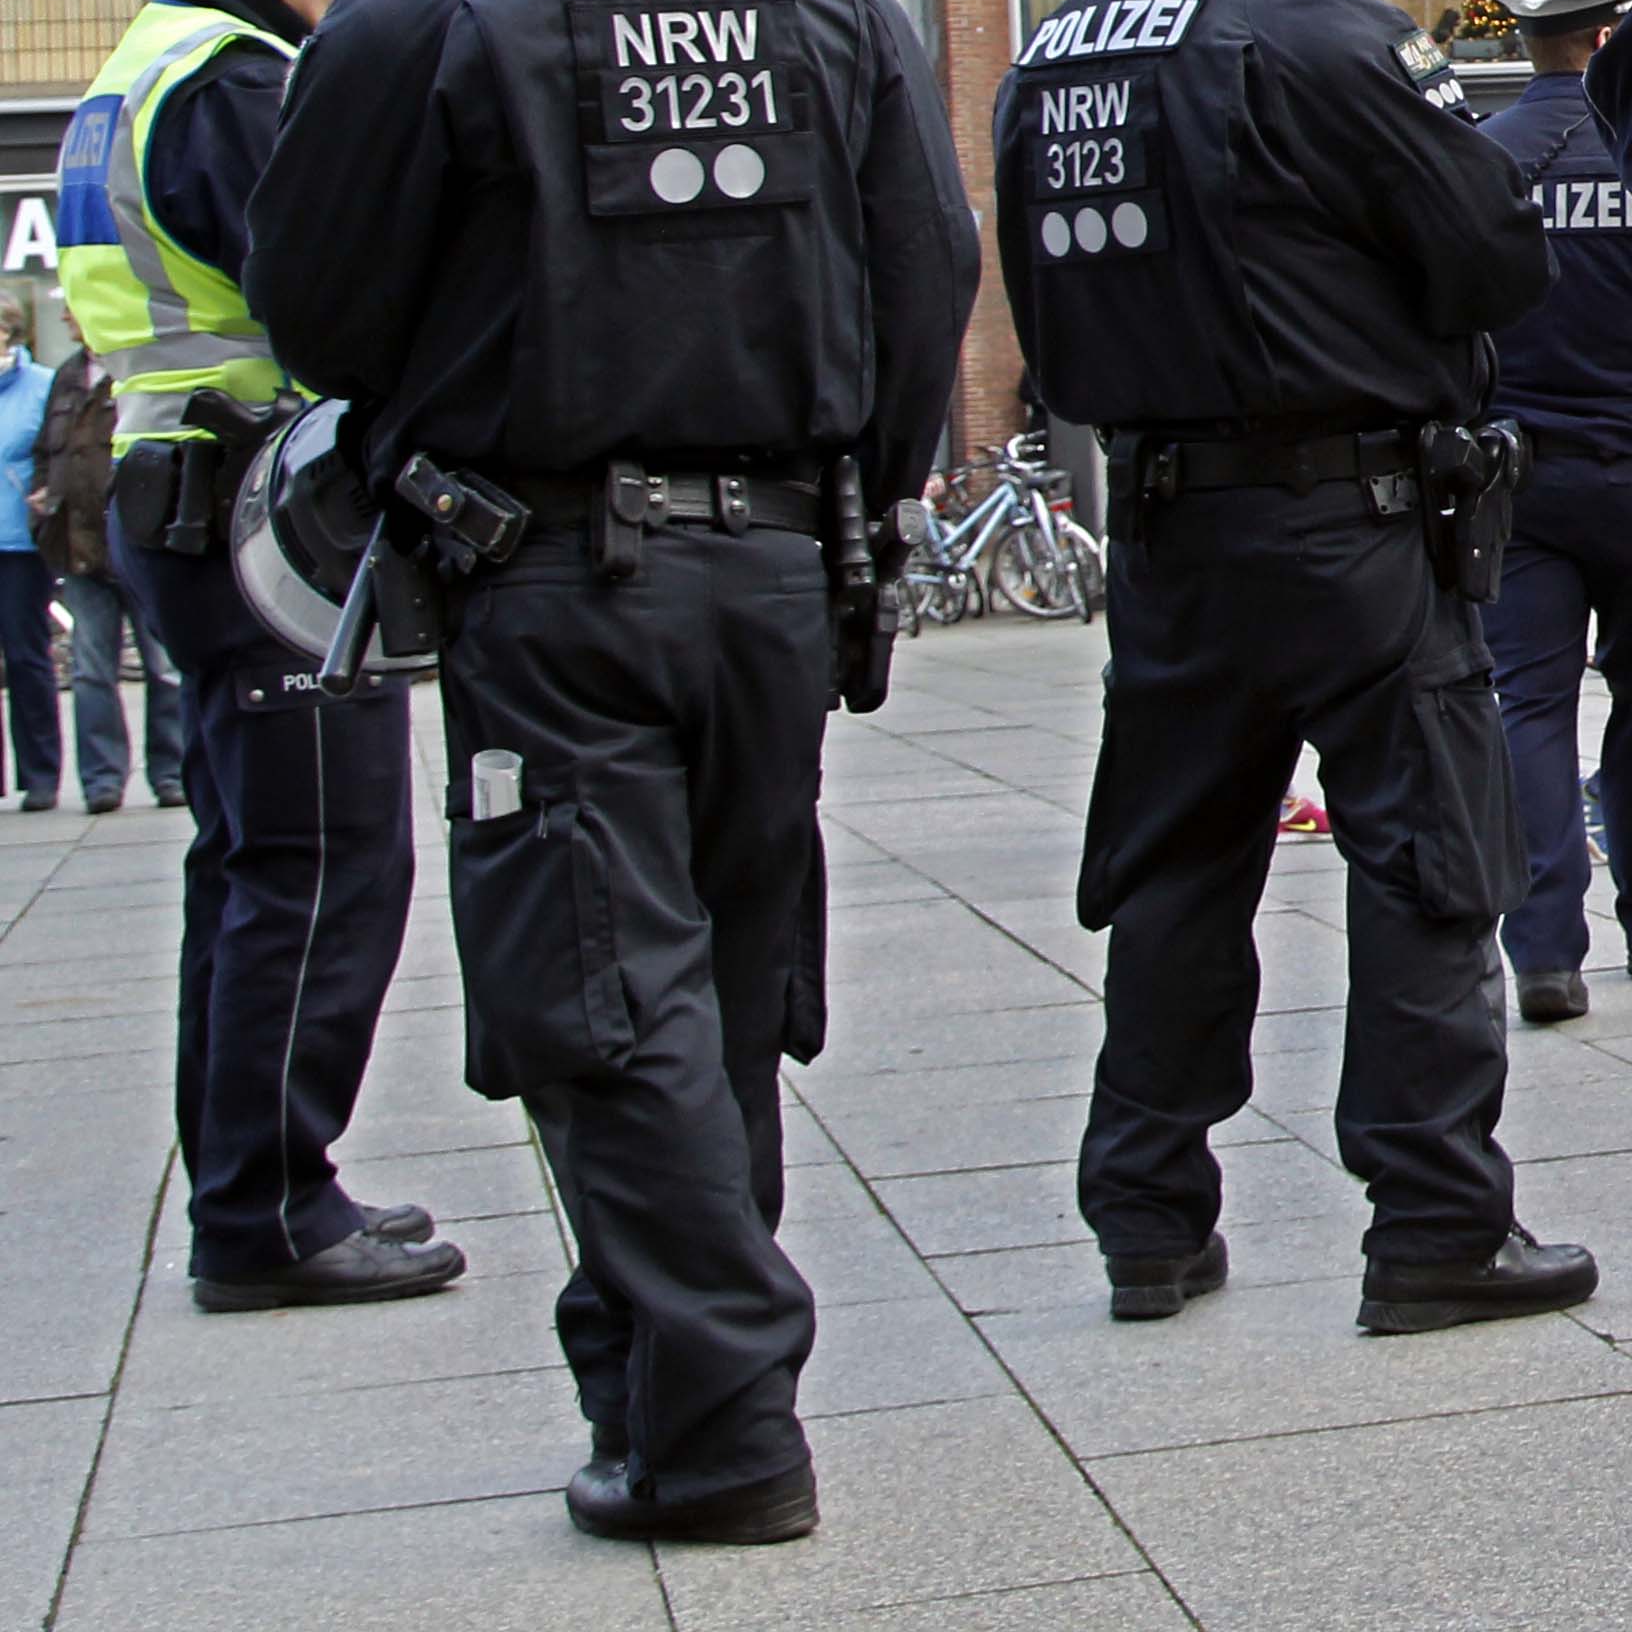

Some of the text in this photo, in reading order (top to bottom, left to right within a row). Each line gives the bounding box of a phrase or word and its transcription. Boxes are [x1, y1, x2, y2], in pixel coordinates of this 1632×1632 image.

[612, 9, 758, 67] NRW
[618, 70, 778, 132] 31231
[1040, 79, 1131, 135] NRW
[1046, 137, 1126, 189] 3123
